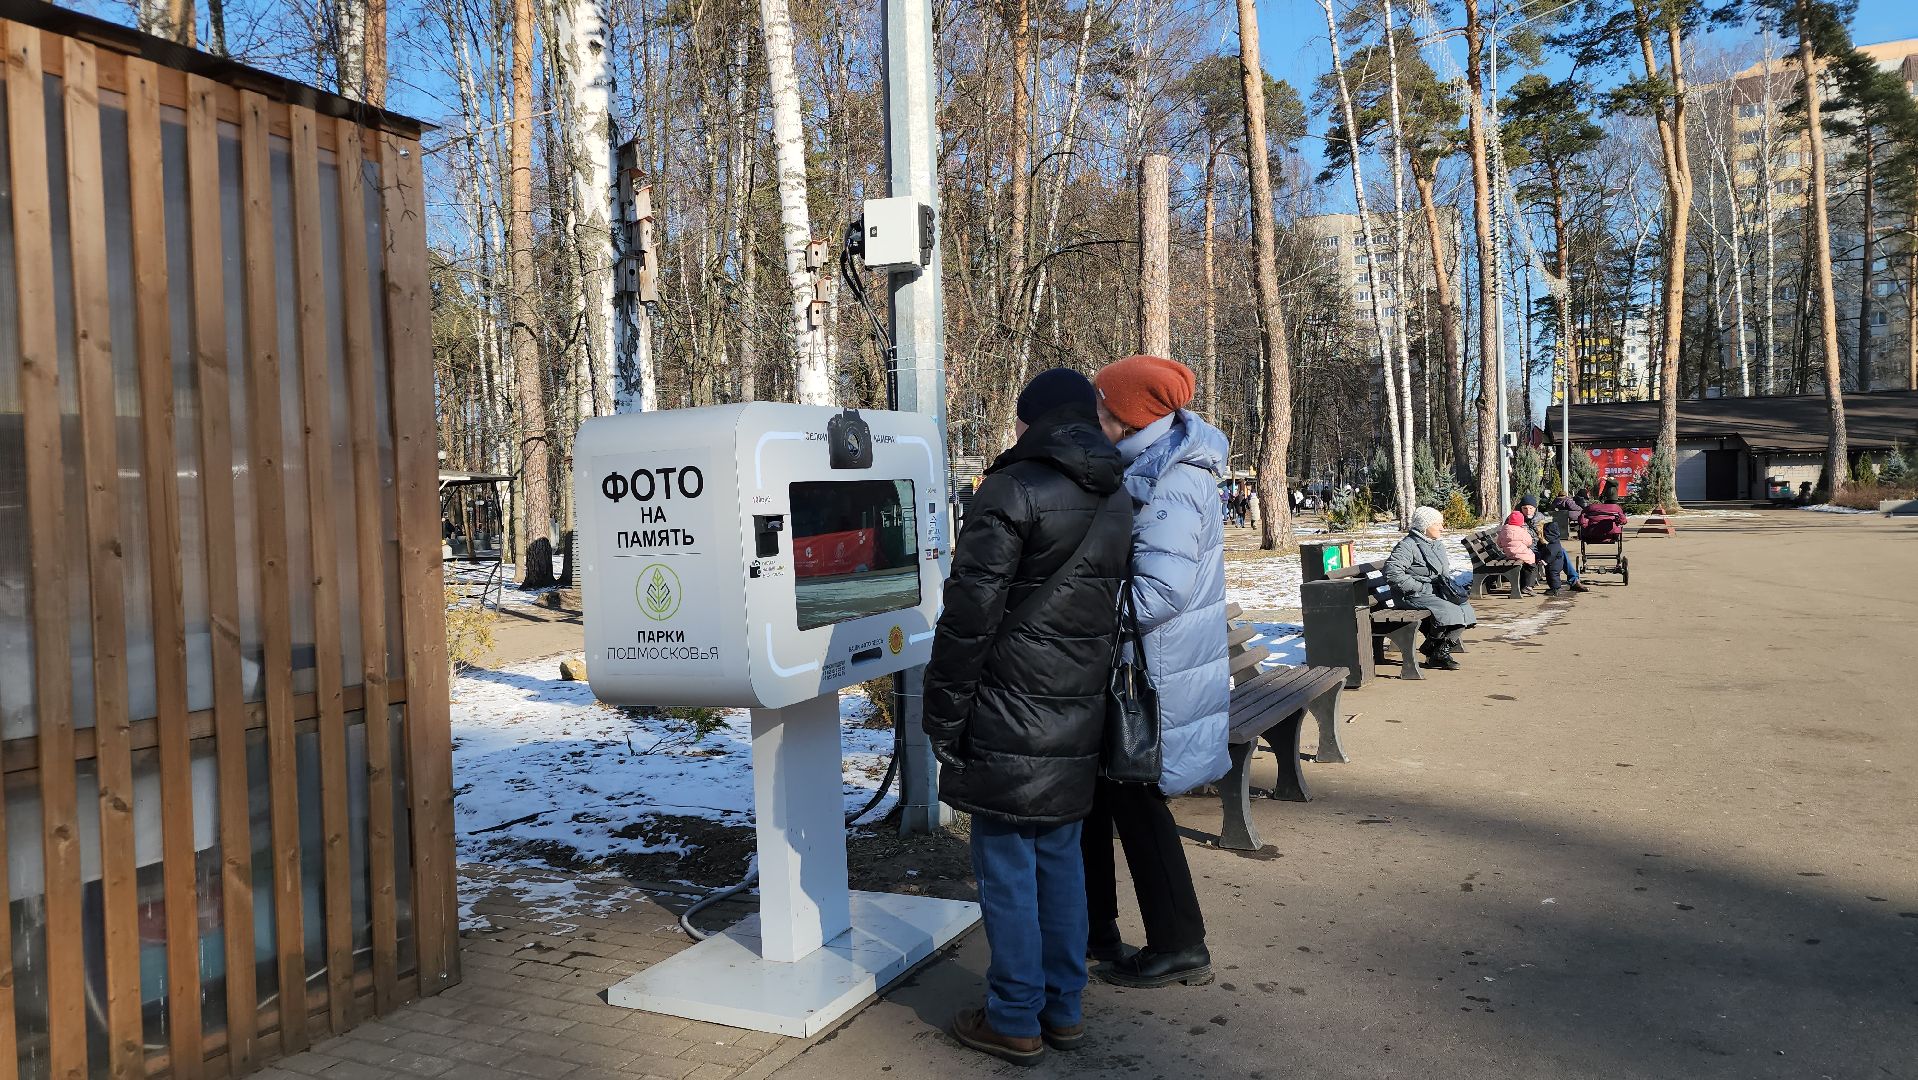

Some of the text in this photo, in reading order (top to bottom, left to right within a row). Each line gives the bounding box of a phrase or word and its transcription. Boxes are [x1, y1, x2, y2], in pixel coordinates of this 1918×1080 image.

[602, 466, 703, 502] ФОТО
[640, 506, 667, 523] НА
[617, 529, 695, 548] ПАМЯТЬ
[637, 631, 685, 643] ПАРКИ
[607, 647, 719, 660] ПОДМОСКОВЬЯ
